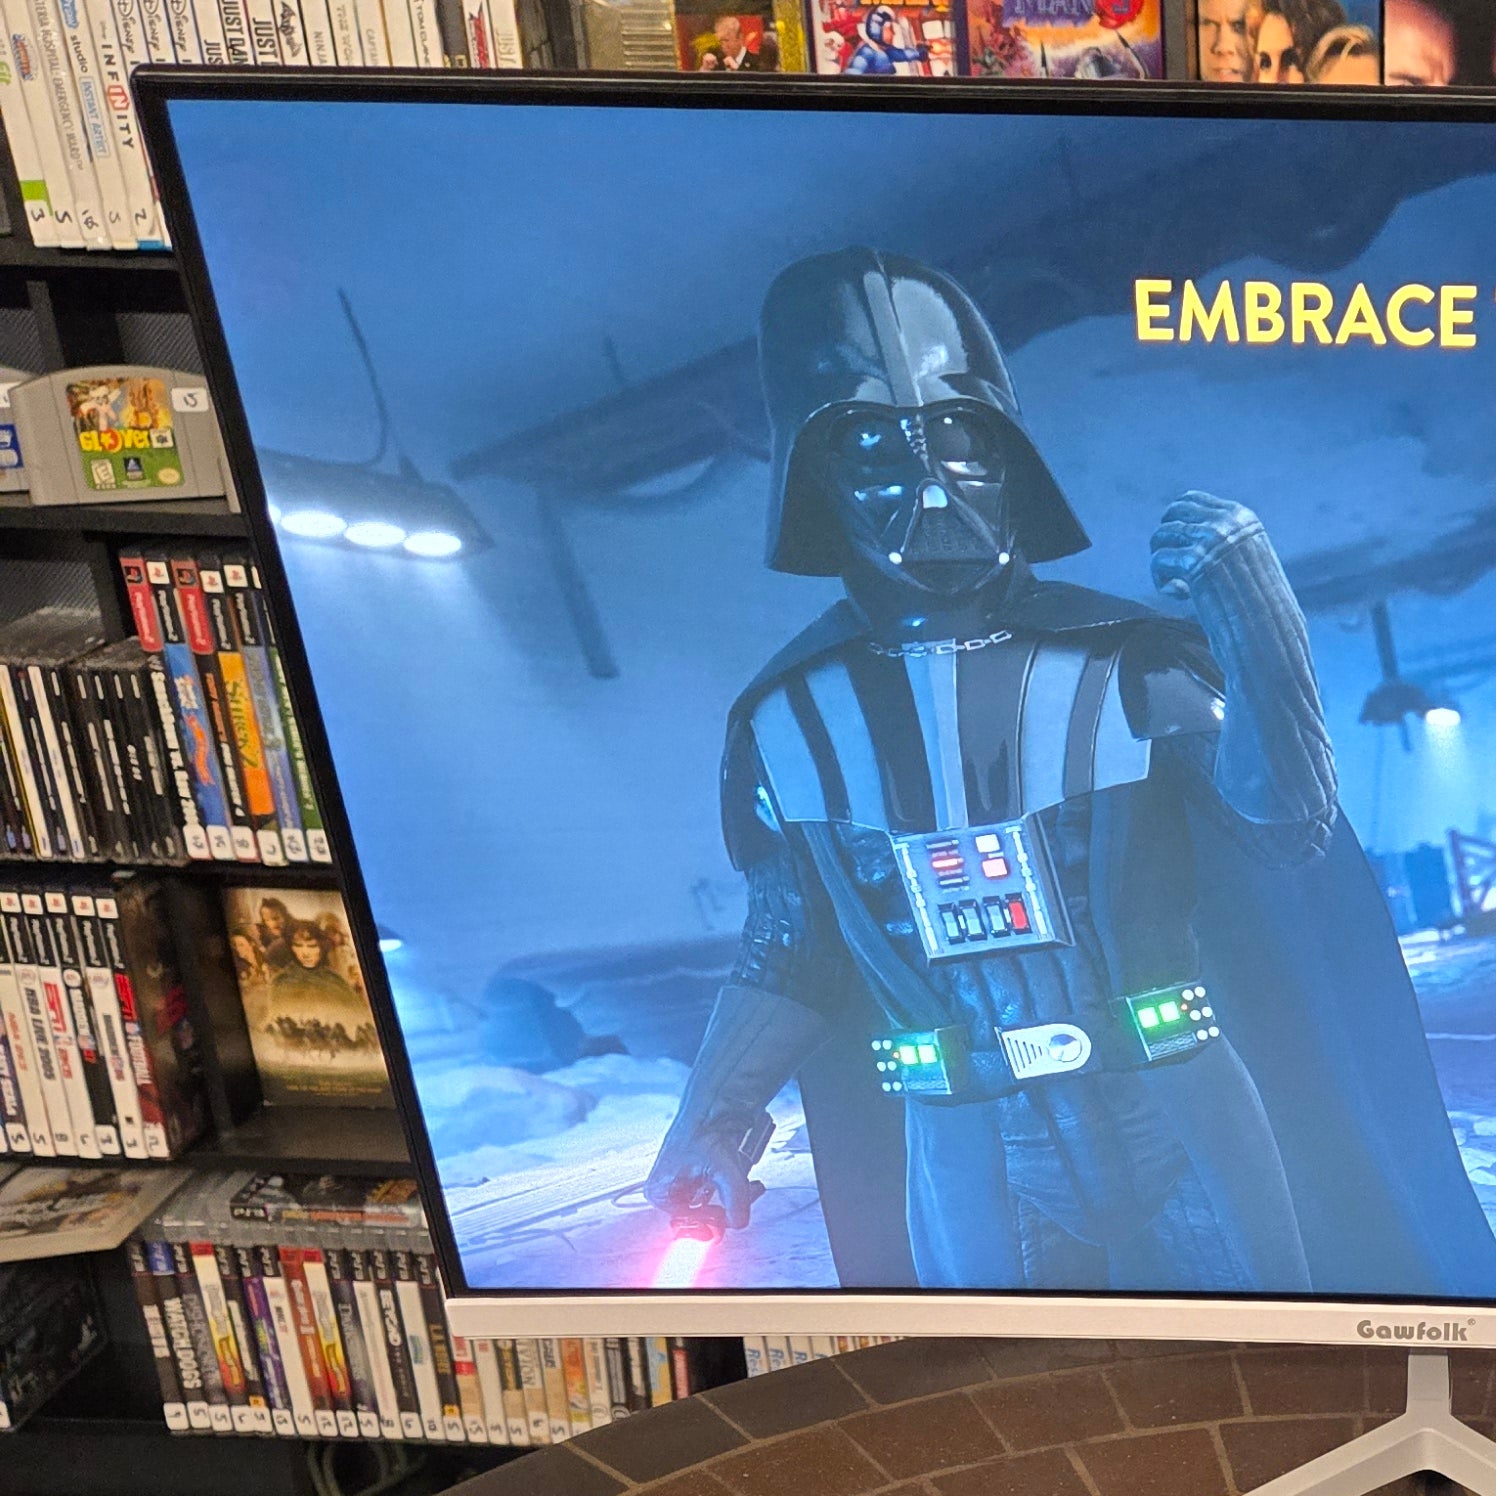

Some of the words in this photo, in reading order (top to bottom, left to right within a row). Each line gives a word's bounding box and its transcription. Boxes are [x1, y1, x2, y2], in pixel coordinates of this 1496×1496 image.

[221, 0, 244, 35] JUST
[70, 34, 89, 73] studio
[204, 39, 224, 65] JUS
[252, 17, 278, 58] JUST
[82, 80, 99, 124] INSTANT
[100, 44, 135, 149] INFINITY
[31, 208, 45, 222] 3
[55, 210, 72, 225] 5
[1136, 280, 1476, 347] EMBRACE
[24, 988, 40, 1013] NBA
[31, 1018, 47, 1044] LIVE
[127, 1036, 151, 1083] FOOTBALL
[1356, 1319, 1468, 1342] Gawfolk
